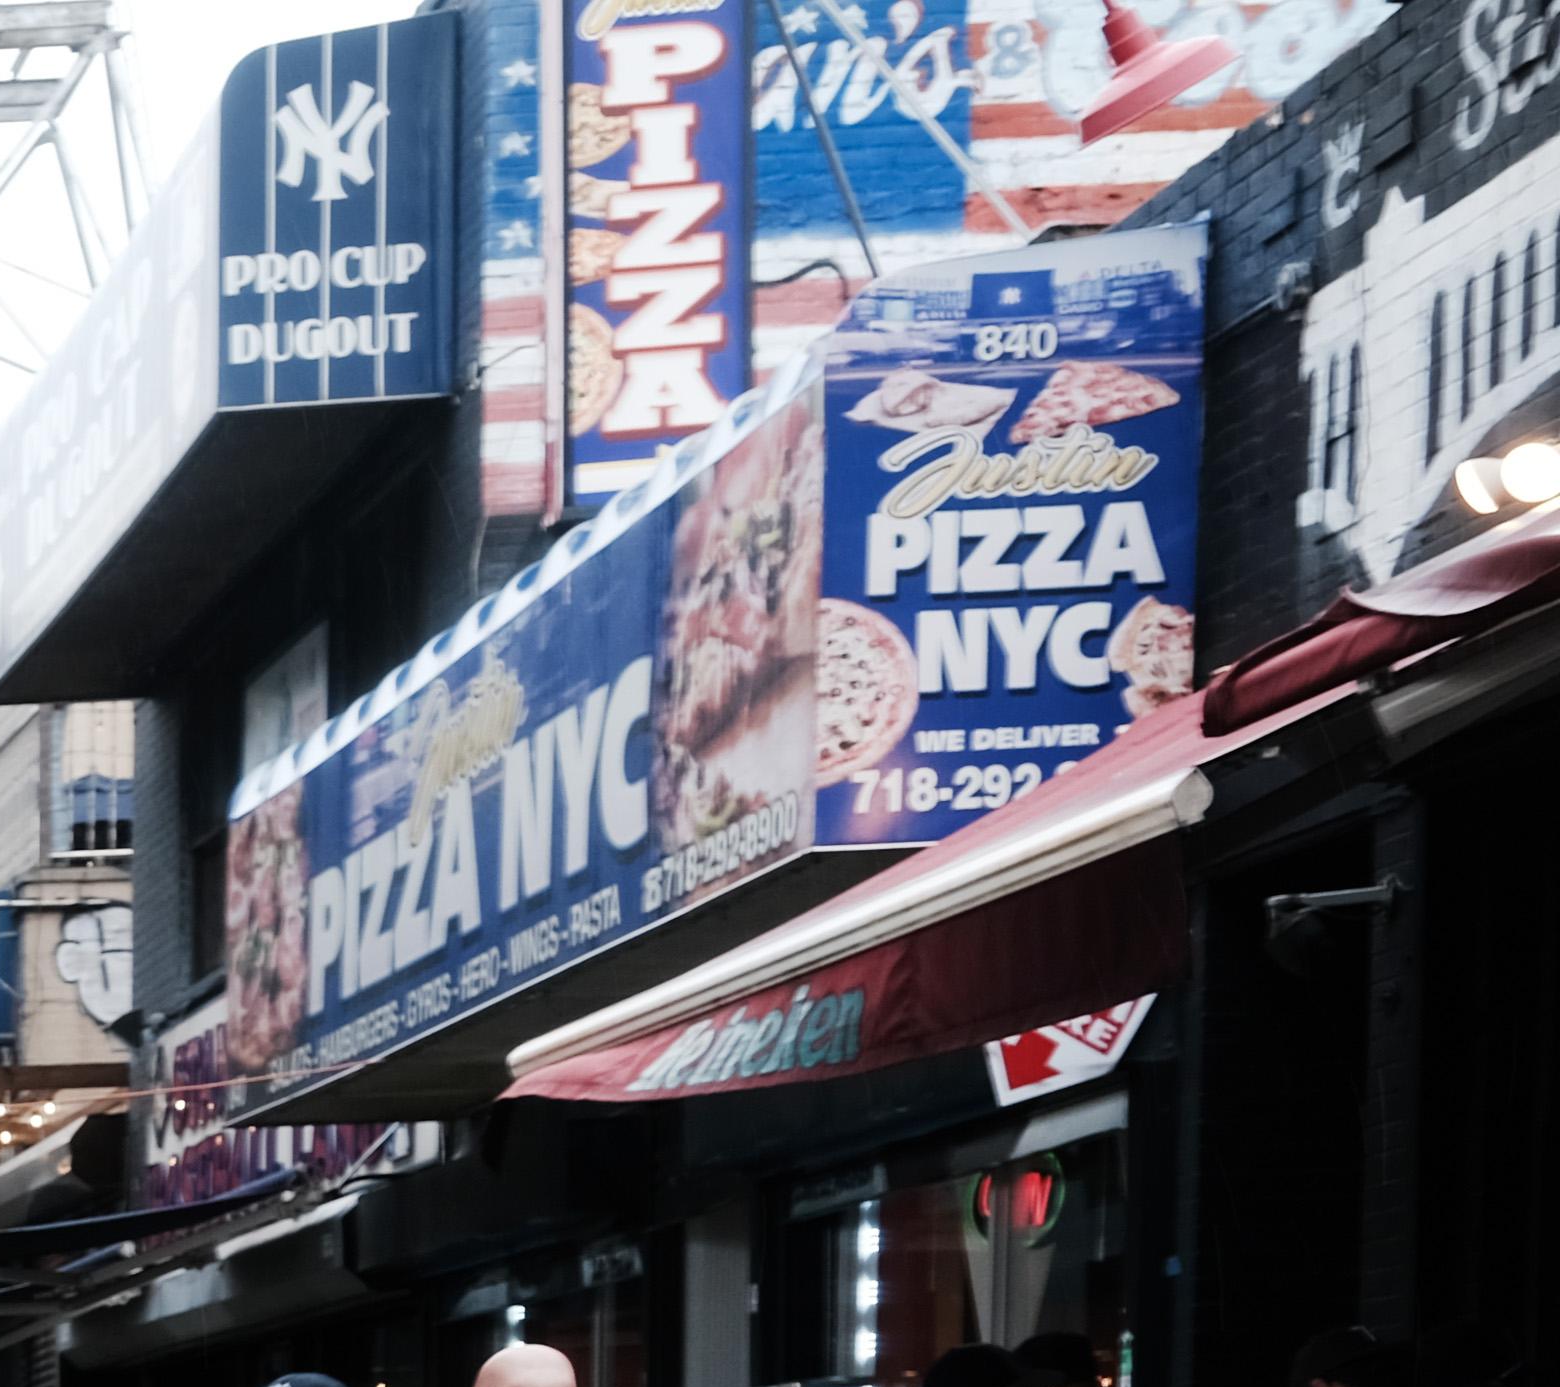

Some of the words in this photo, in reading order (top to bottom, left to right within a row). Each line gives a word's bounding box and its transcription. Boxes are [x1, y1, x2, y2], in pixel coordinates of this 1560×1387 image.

[276, 80, 390, 201] NY
[222, 250, 319, 297] PRO
[331, 242, 427, 289] CUP
[601, 22, 727, 440] PIZZA
[228, 312, 419, 365] DUGOUT
[973, 322, 1058, 361] 840
[878, 422, 1160, 519] Justin
[865, 502, 1166, 596] PIZZA
[918, 602, 1113, 693] NYC
[914, 730, 965, 754] WE
[972, 723, 1100, 753] DELIVER
[850, 761, 1078, 814] 718-292
[309, 780, 482, 1016] PIZZA
[498, 656, 653, 912] NYC
[406, 972, 452, 1028] GYROS
[459, 946, 500, 1003] HERO
[509, 914, 560, 975] WINGS
[569, 883, 622, 946] PASTA
